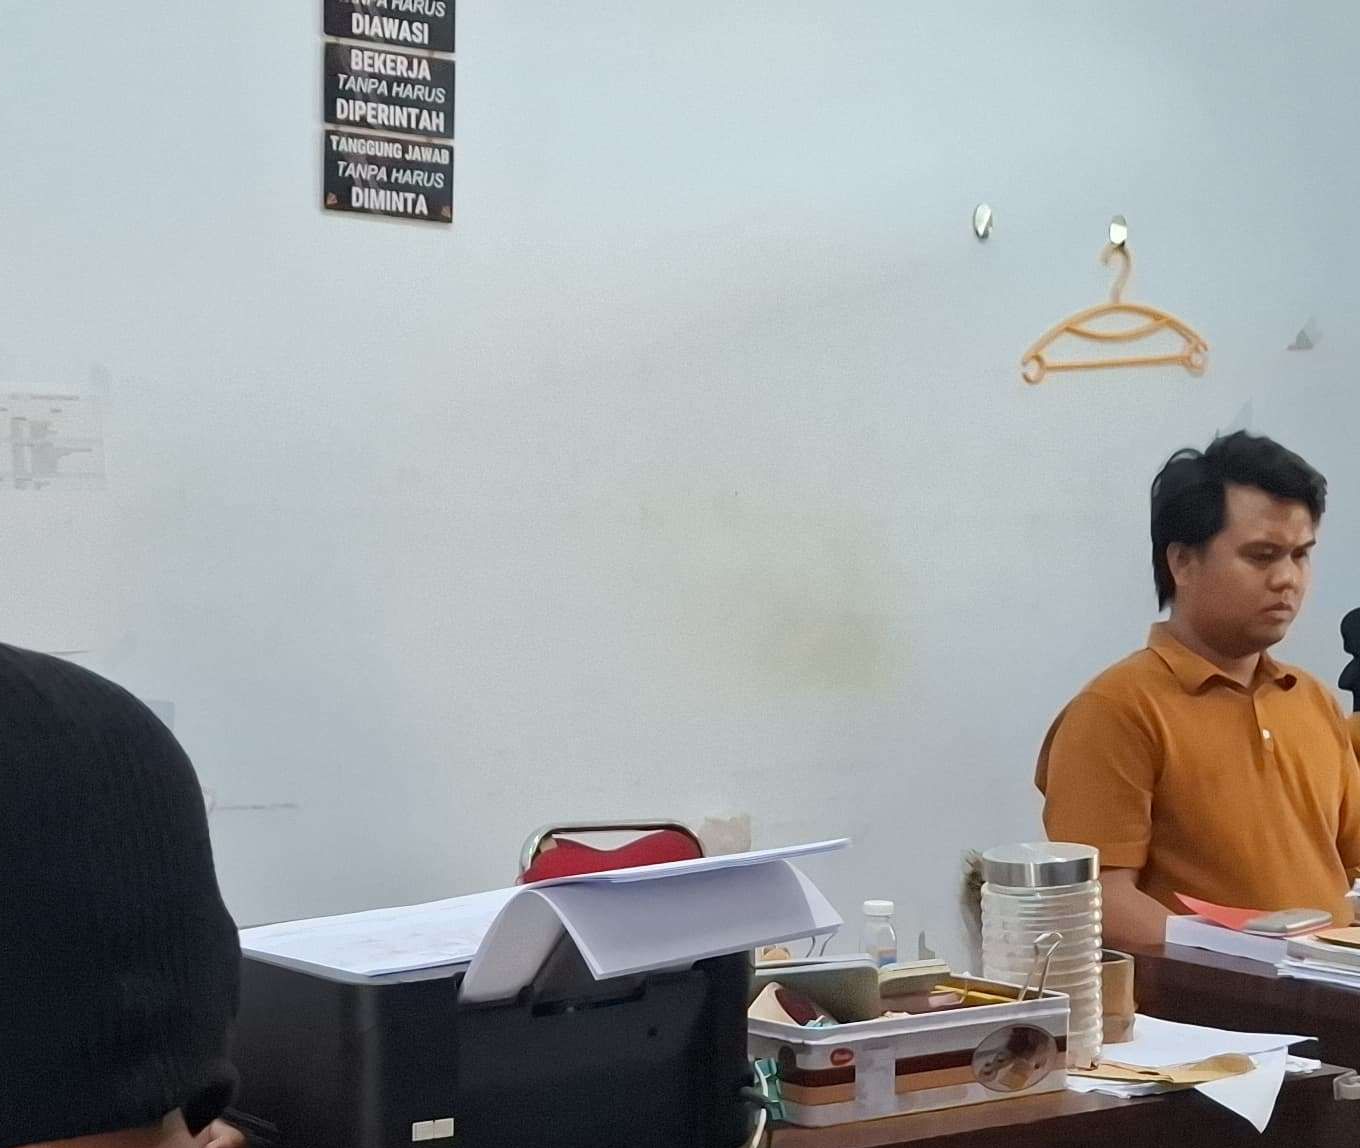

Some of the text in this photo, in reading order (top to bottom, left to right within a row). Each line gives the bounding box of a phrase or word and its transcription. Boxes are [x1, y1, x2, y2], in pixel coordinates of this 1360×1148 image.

[391, 0, 446, 18] HARUS
[351, 12, 429, 45] DIAWASI
[350, 49, 431, 81] BEKERJA
[337, 73, 446, 104] TANPA HARUS
[336, 98, 445, 133] DIPERINTAH
[330, 135, 450, 165] TANGGUNG JAWAB
[337, 160, 445, 190] TANPA HARUS
[351, 185, 429, 217] DIMINTA
